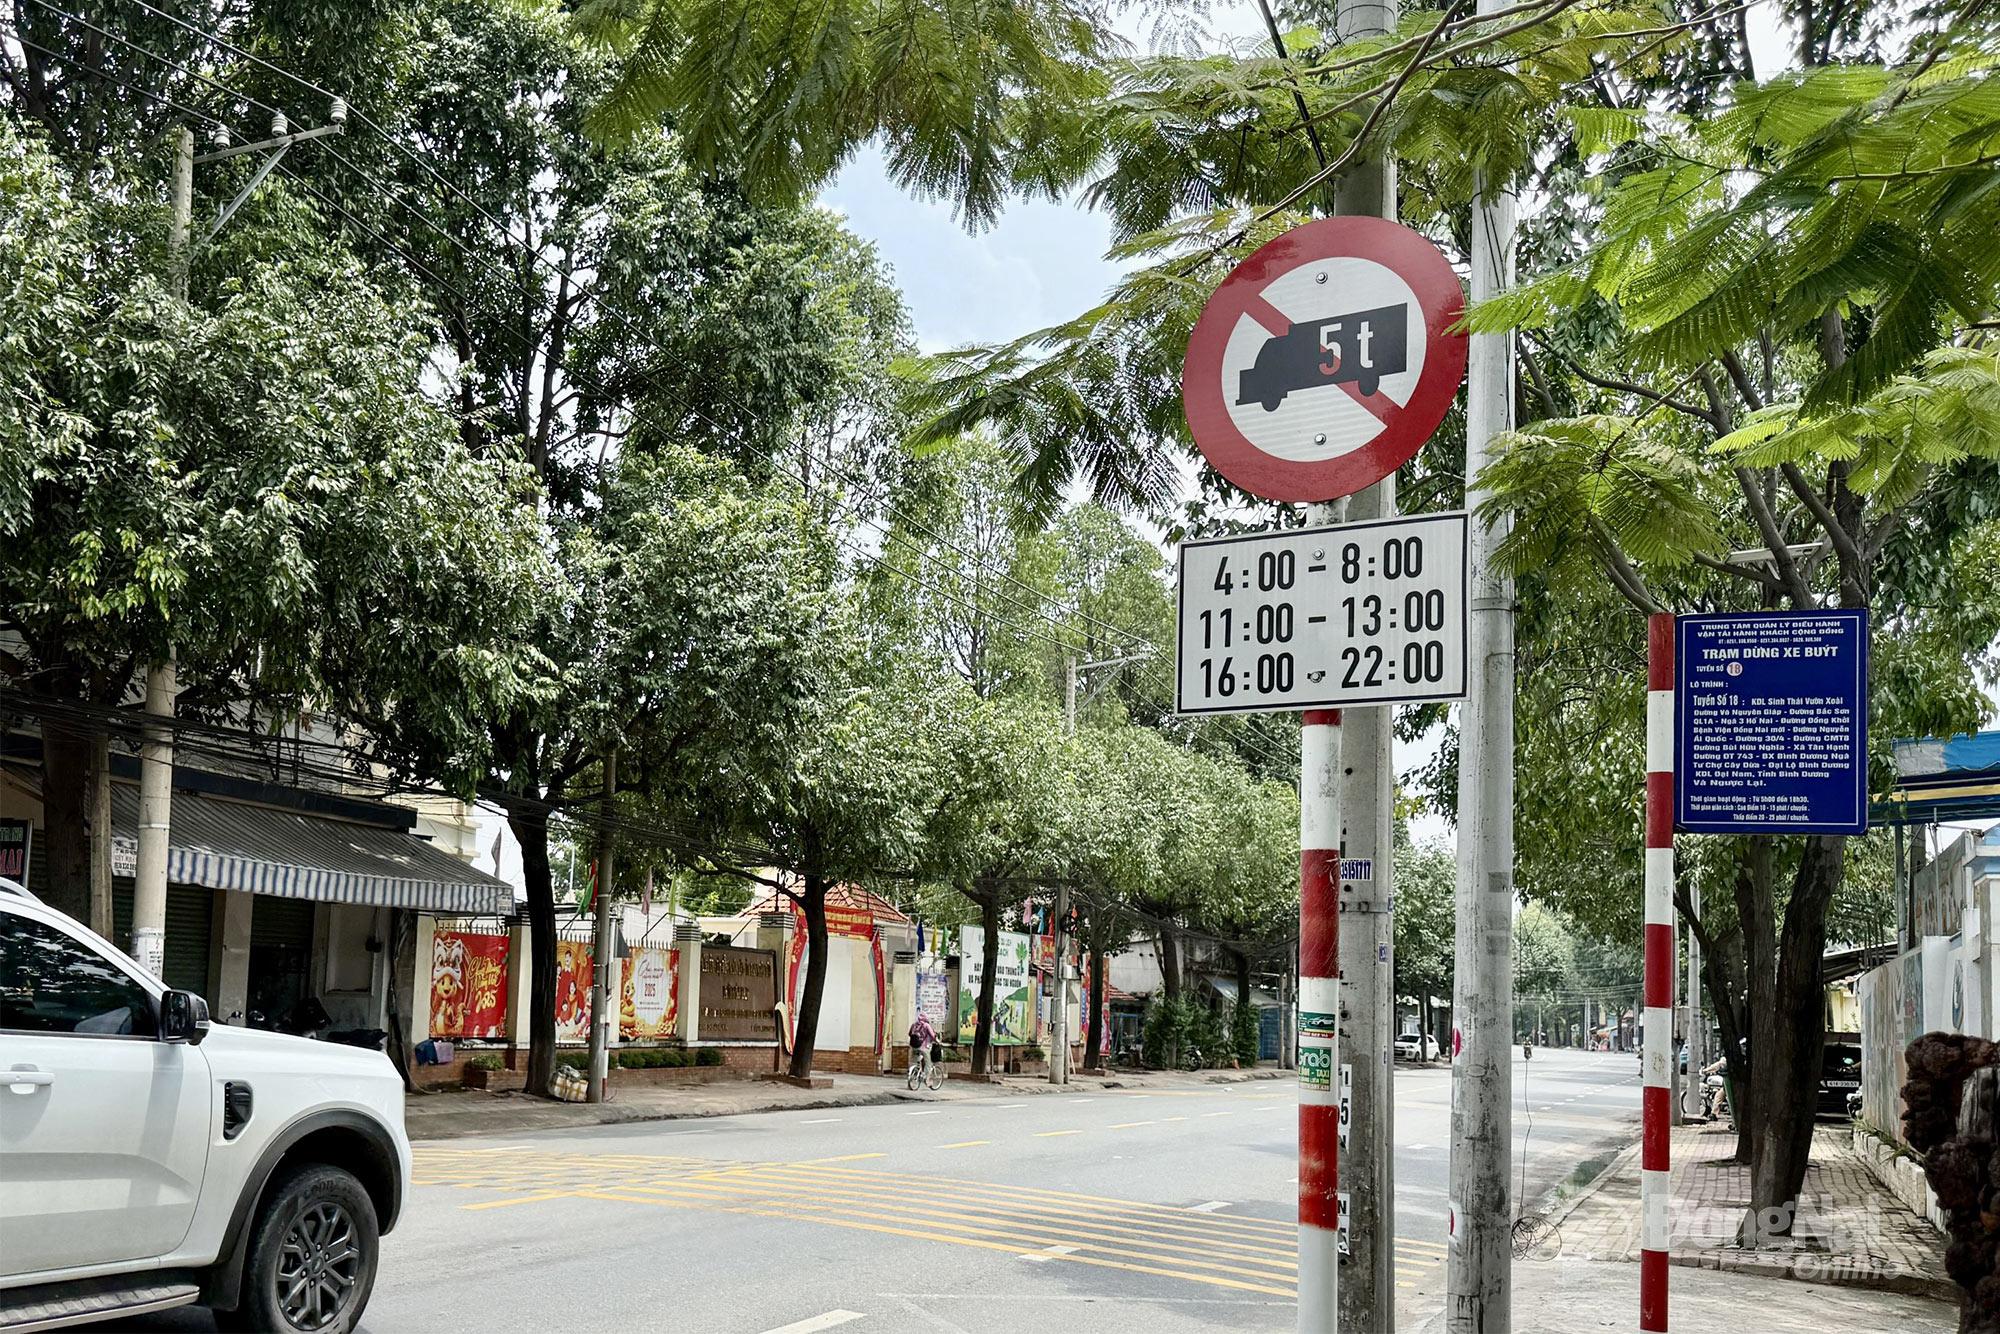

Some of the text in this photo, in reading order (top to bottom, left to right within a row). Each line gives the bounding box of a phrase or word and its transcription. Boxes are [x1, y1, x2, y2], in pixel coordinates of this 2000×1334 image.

[1319, 321, 1373, 375] 5 t
[1214, 549, 1295, 595] 4:00
[1342, 536, 1422, 584] 8:00
[1200, 602, 1293, 649] 11:00
[1343, 589, 1444, 637] 13:00
[1702, 644, 1838, 661] TRẠM DỪNG XE BUÝT
[1200, 652, 1294, 698] 16:00
[1342, 641, 1443, 689] 22:00
[1697, 664, 1714, 672] TUYẾN
[1730, 664, 1740, 674] 18
[1693, 694, 1714, 707] Tuyến
[1717, 693, 1727, 705] Số
[1730, 695, 1738, 705] 18
[1787, 697, 1803, 705] Thái
[1820, 725, 1849, 733] Nguyễn
[1316, 1069, 1329, 1077] TAXI
